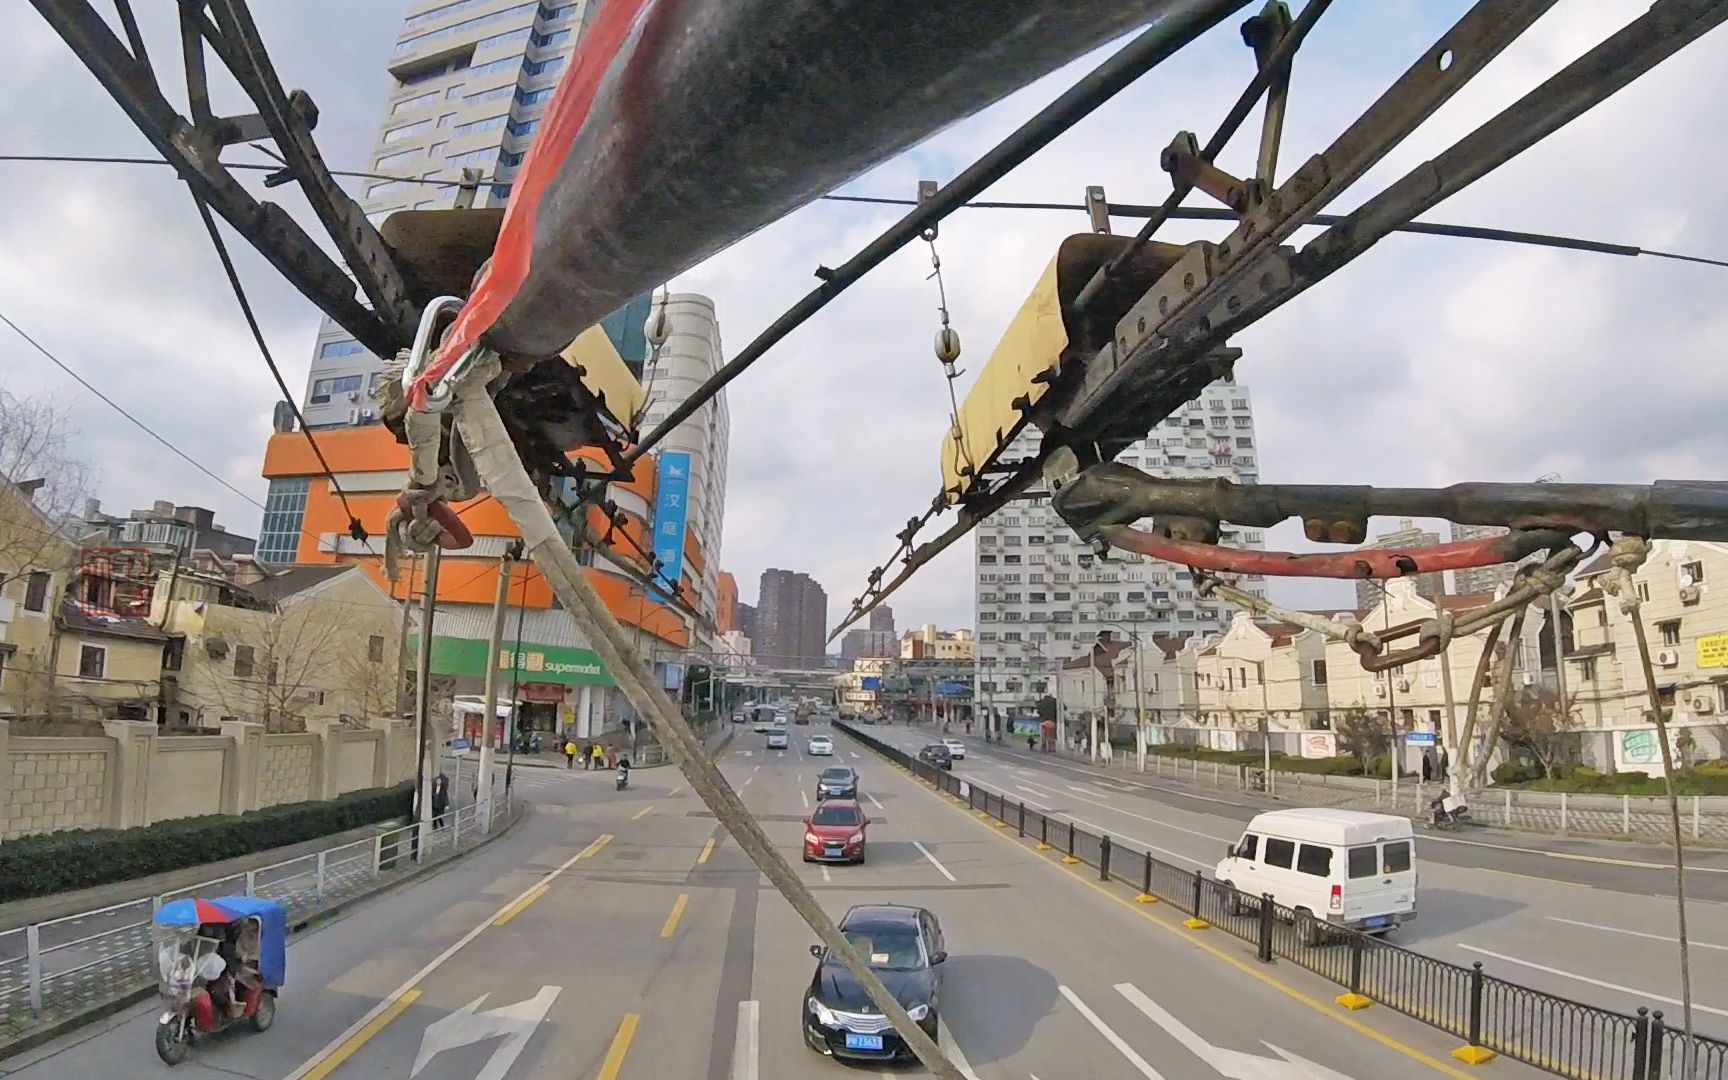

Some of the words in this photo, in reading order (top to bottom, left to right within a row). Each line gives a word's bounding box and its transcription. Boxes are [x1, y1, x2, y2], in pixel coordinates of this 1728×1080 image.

[660, 493, 681, 586] 汉庭酒
[544, 661, 601, 675] supermarket
